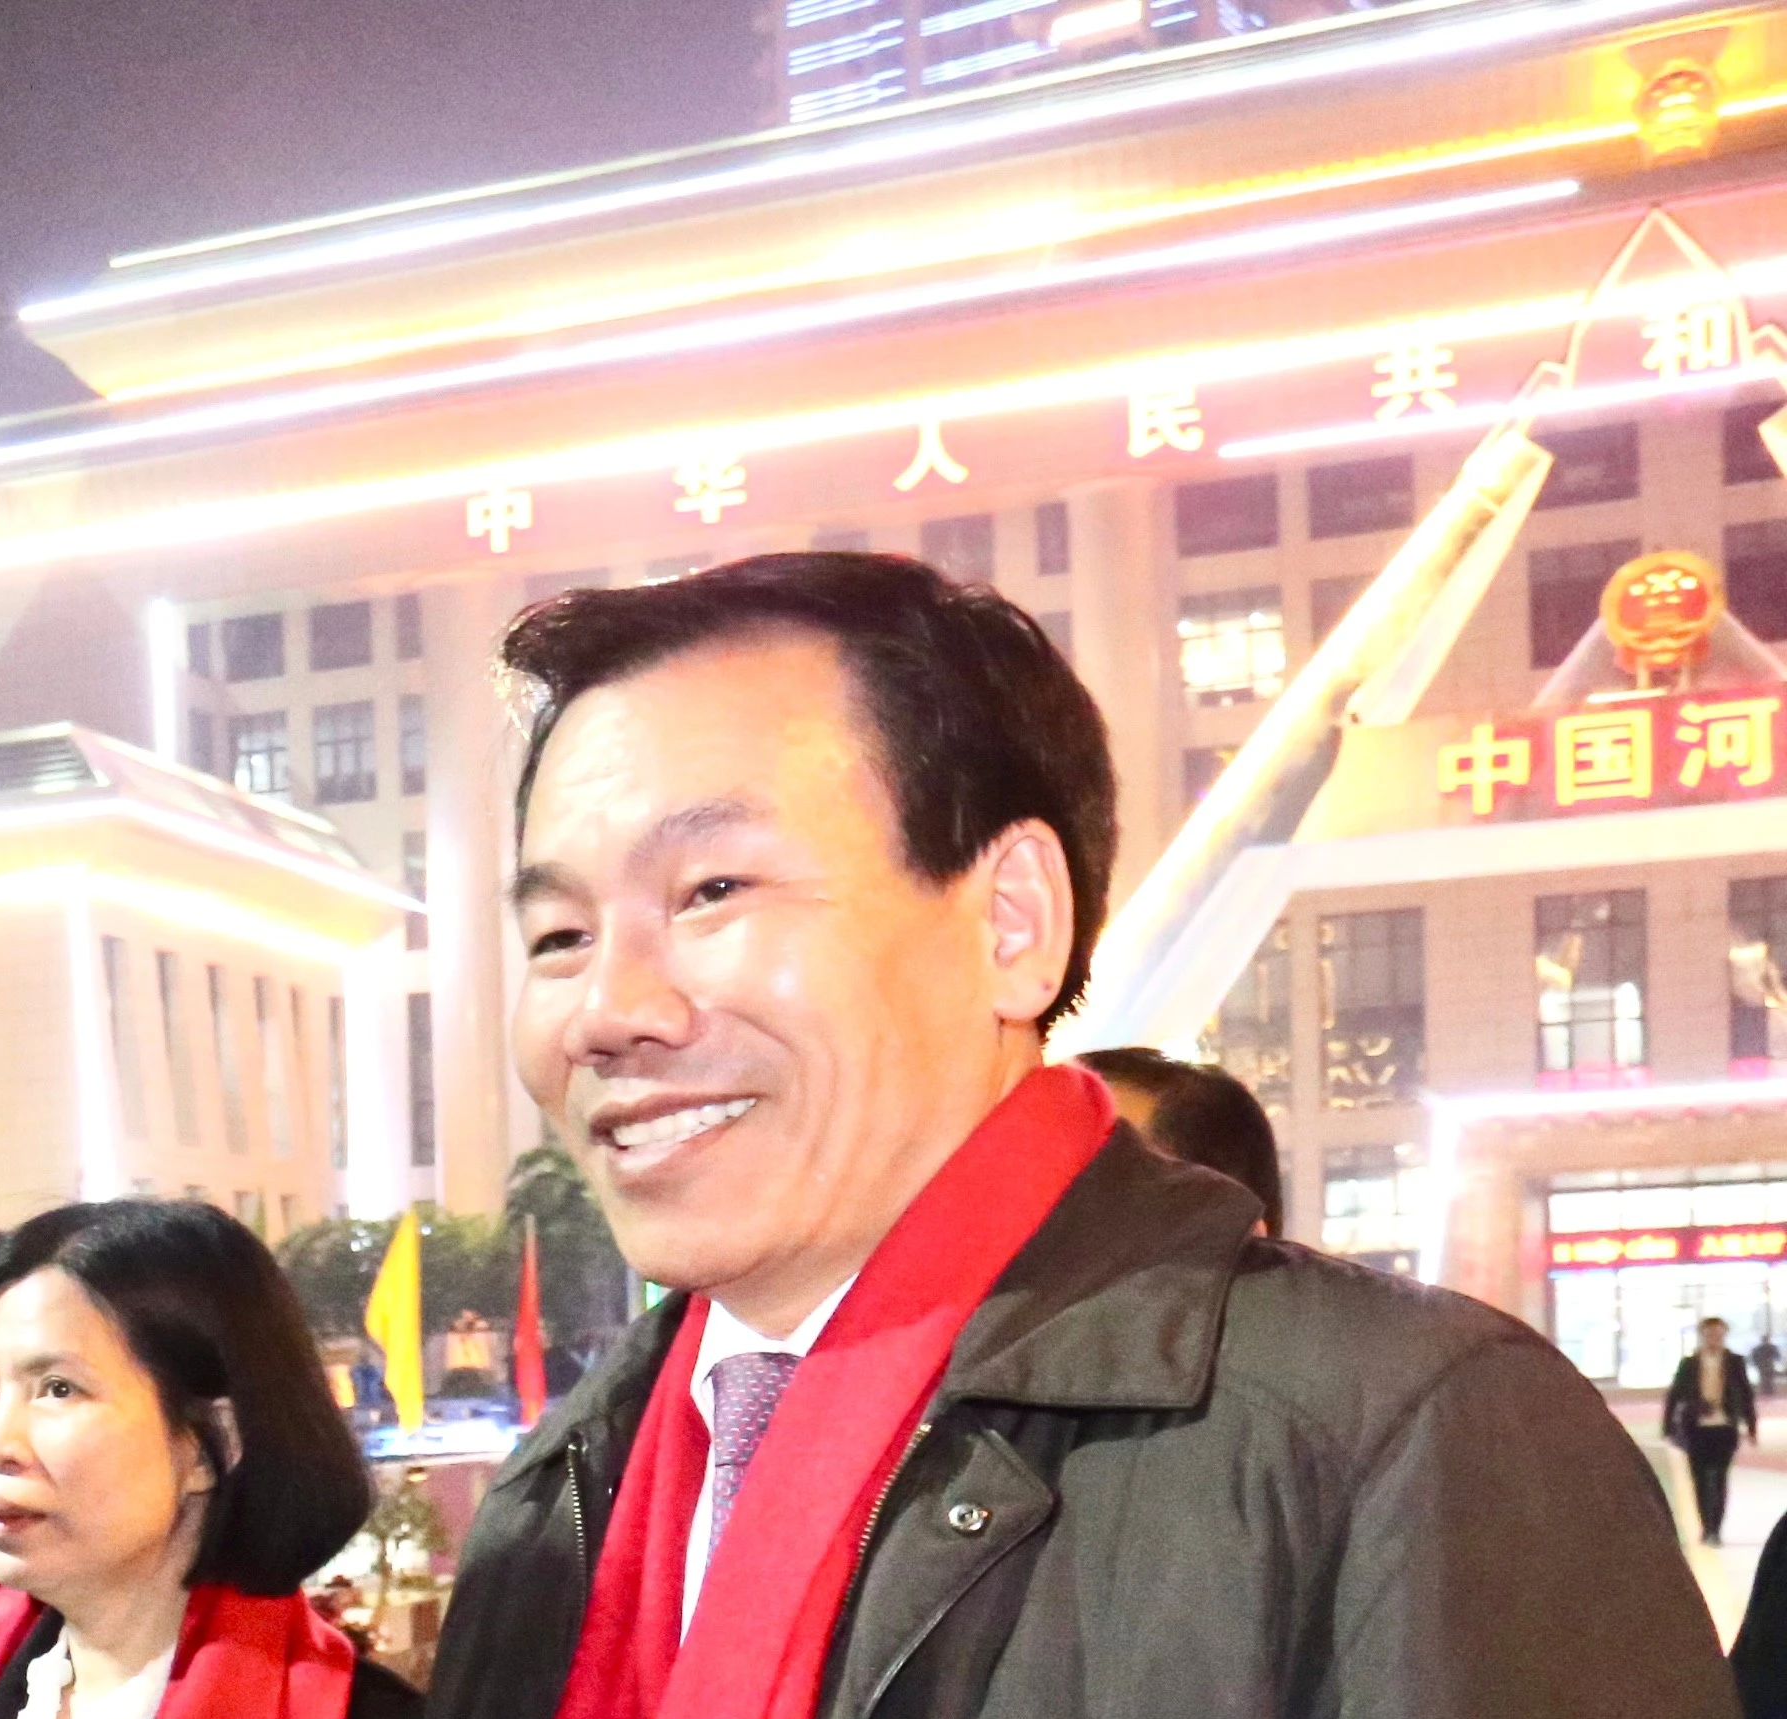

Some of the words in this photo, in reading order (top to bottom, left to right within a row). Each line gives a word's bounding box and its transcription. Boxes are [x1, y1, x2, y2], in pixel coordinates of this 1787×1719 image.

[465, 303, 1734, 553] 中华人民共和
[1436, 697, 1780, 815] 中国河
